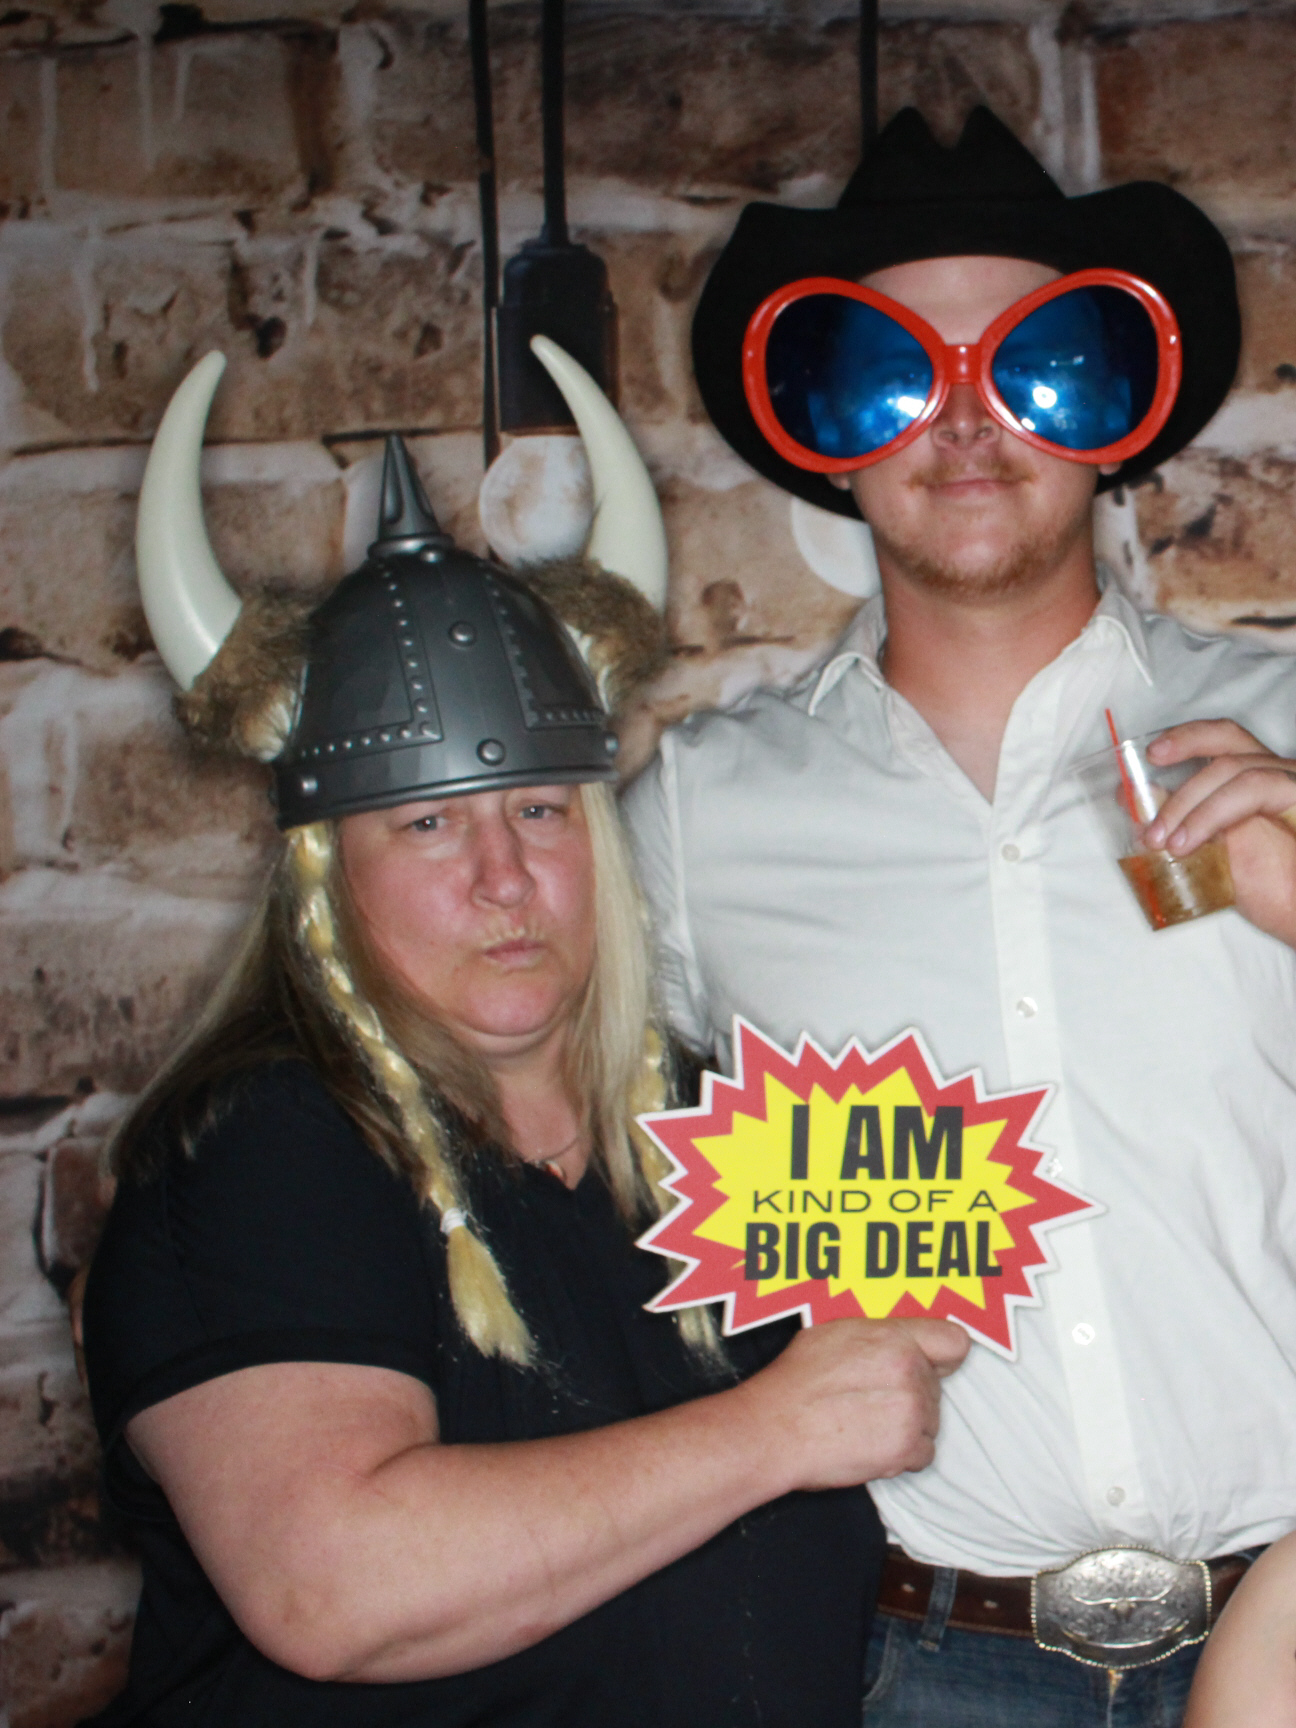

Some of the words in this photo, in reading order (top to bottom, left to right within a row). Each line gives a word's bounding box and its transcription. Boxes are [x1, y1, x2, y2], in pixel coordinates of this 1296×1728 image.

[790, 1104, 810, 1180] I
[839, 1105, 964, 1180] AM
[753, 1190, 871, 1213] KIND
[888, 1190, 953, 1213] OF
[967, 1190, 998, 1213] A
[744, 1222, 841, 1280] BIG
[865, 1221, 1003, 1278] DEAL
